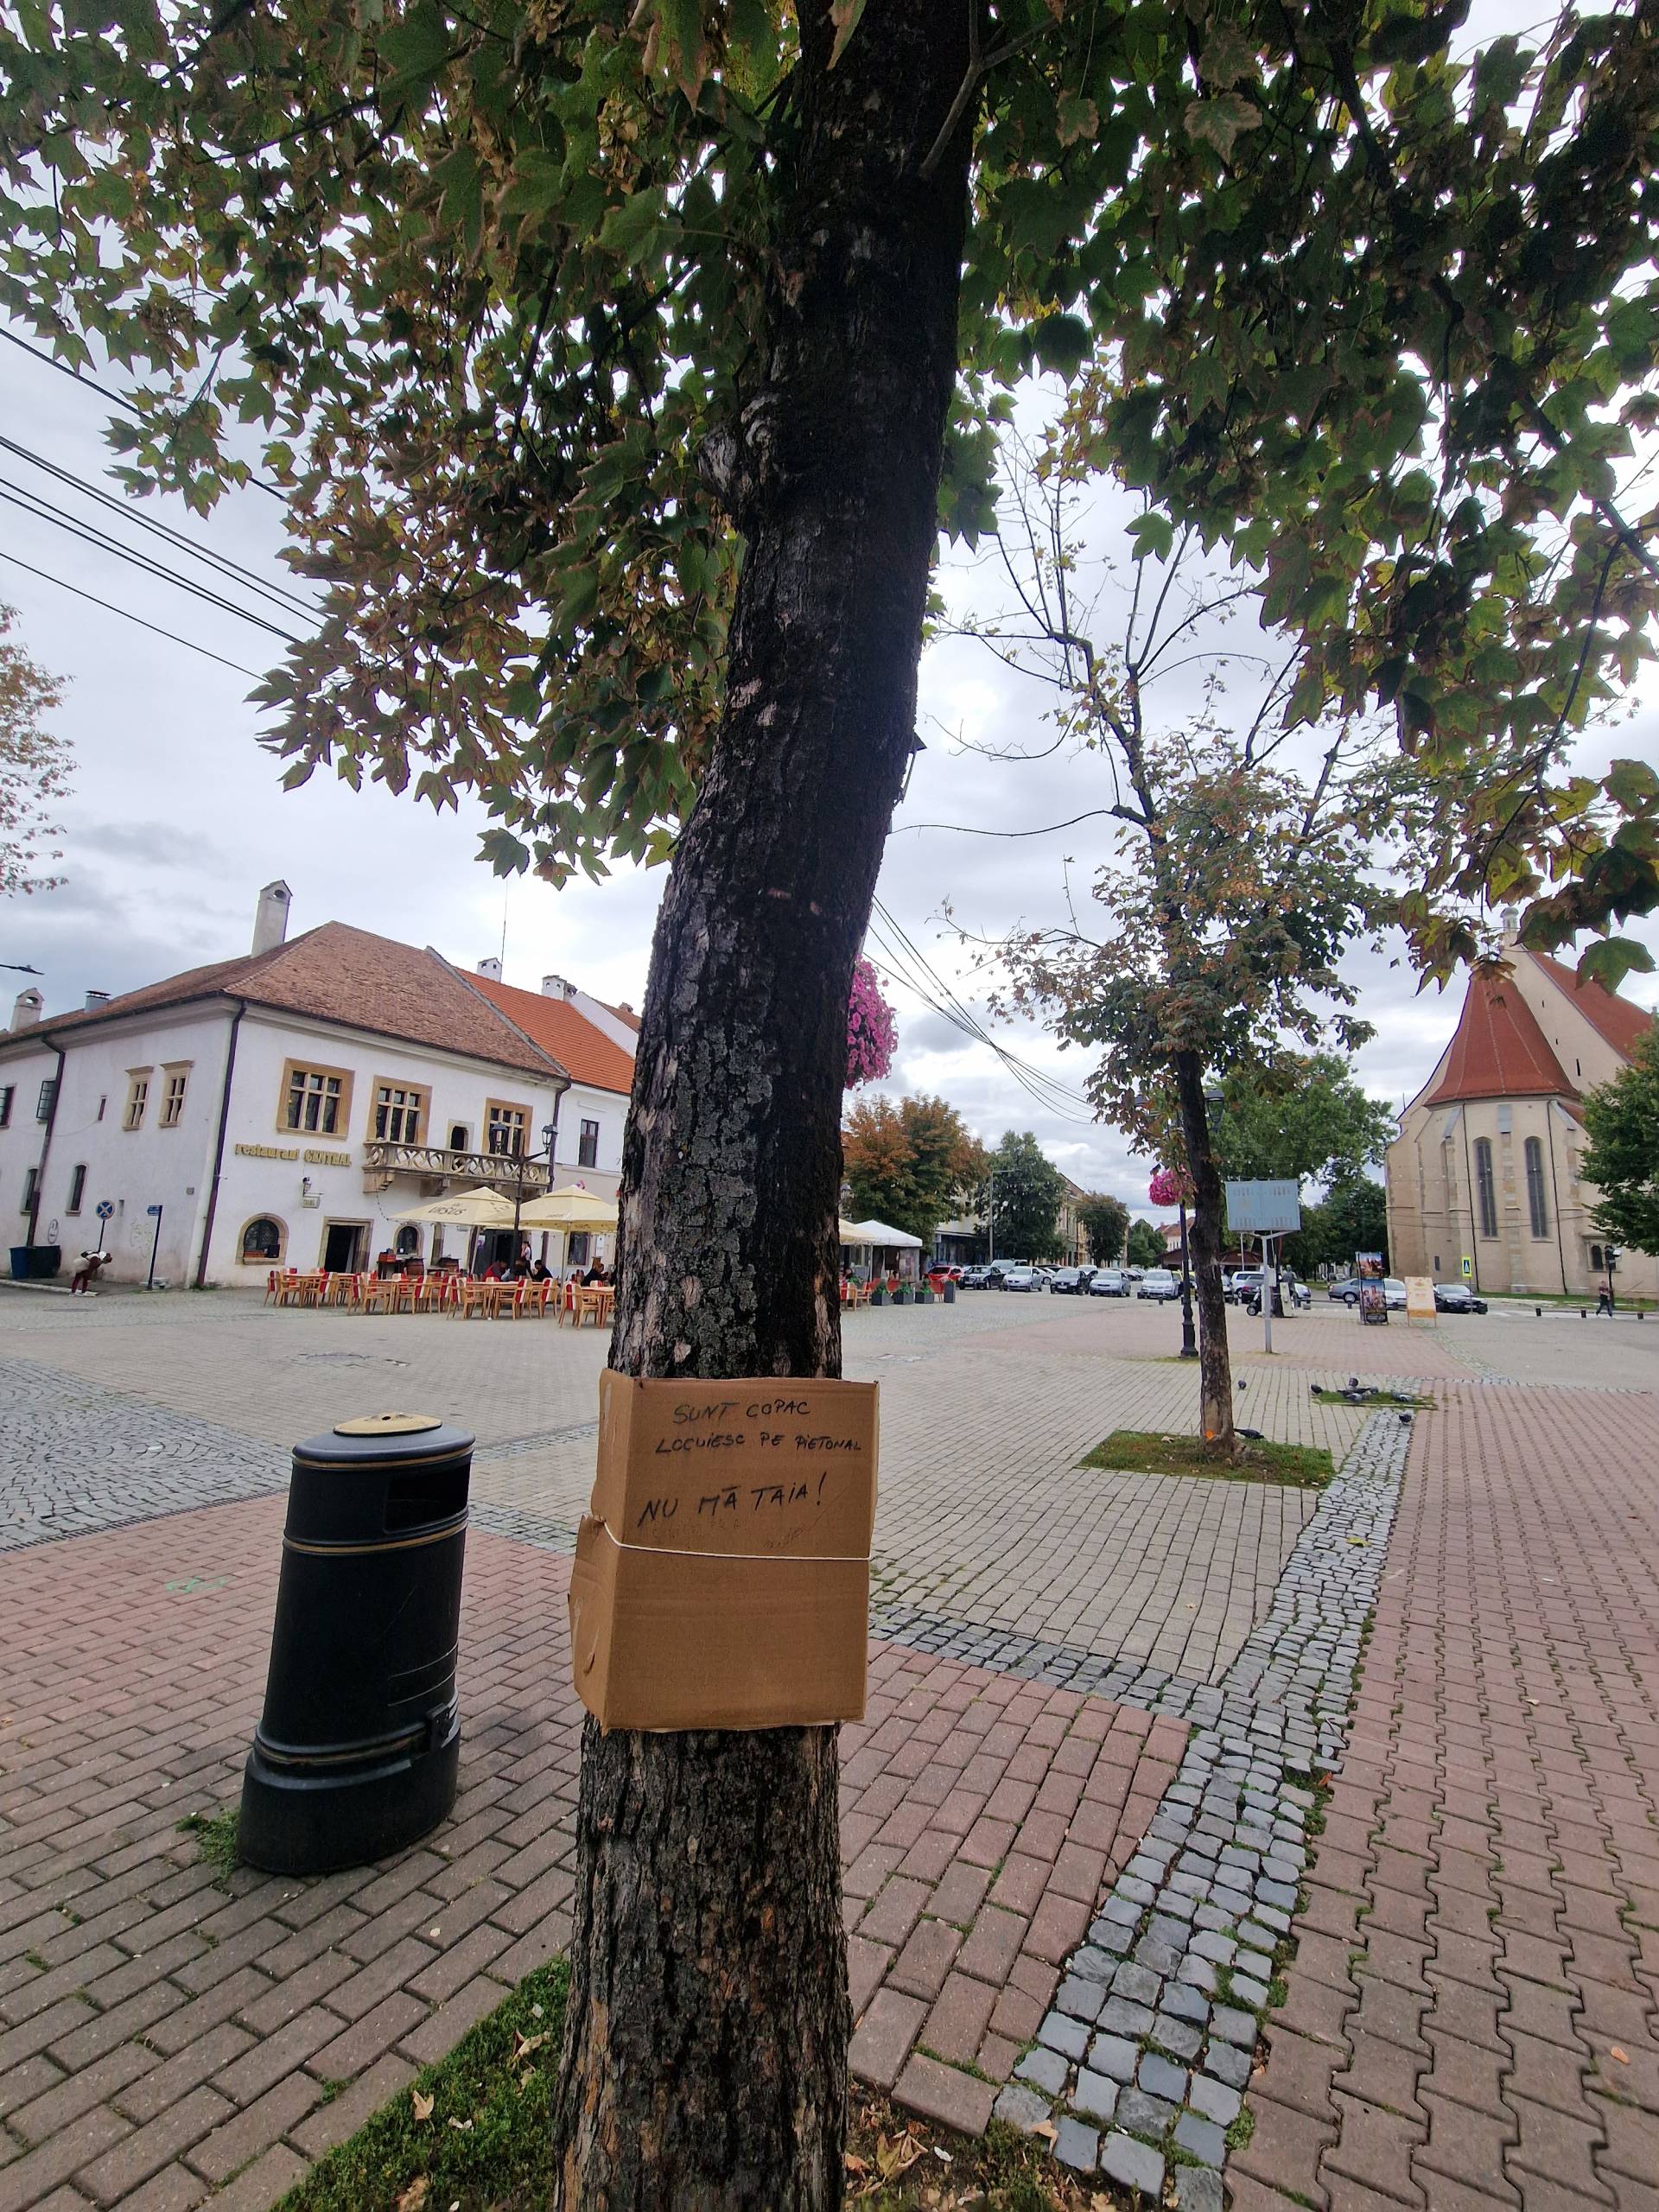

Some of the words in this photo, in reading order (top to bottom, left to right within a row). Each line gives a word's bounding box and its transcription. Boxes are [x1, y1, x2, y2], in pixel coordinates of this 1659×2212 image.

[304, 1148, 352, 1167] CENTRAL
[672, 1402, 741, 1424] SUNT
[746, 1399, 810, 1418] COPAC
[760, 1431, 785, 1447] PE
[637, 1498, 678, 1528] NU
